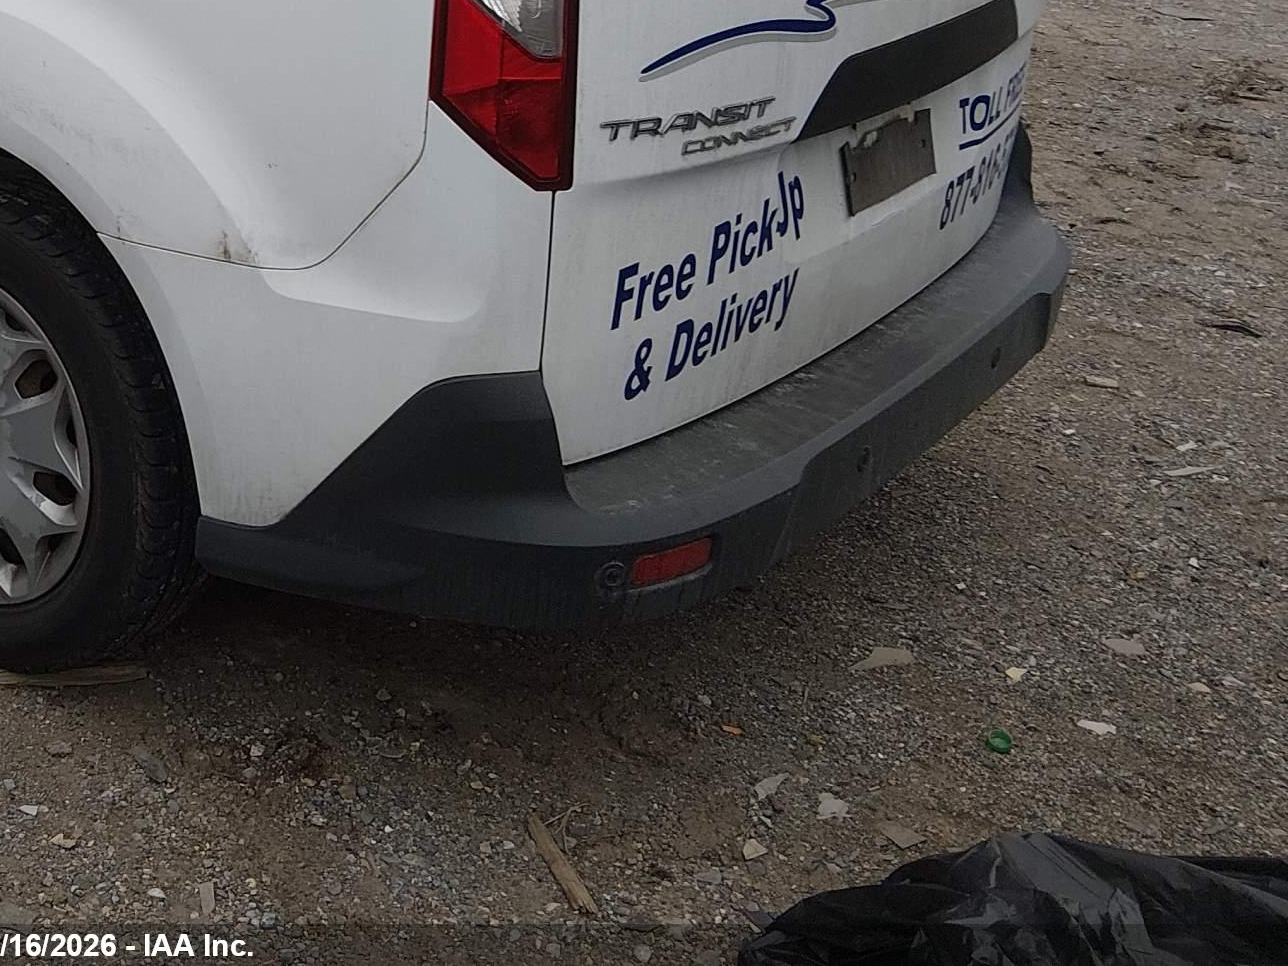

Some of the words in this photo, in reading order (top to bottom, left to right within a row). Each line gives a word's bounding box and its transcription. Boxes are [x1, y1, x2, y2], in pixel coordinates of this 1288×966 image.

[600, 95, 776, 142] TRANSIT
[958, 86, 1002, 135] TOLL
[681, 115, 797, 156] CONNECT
[611, 253, 697, 331] Free
[624, 337, 653, 401] &
[665, 267, 800, 382] Delivery
